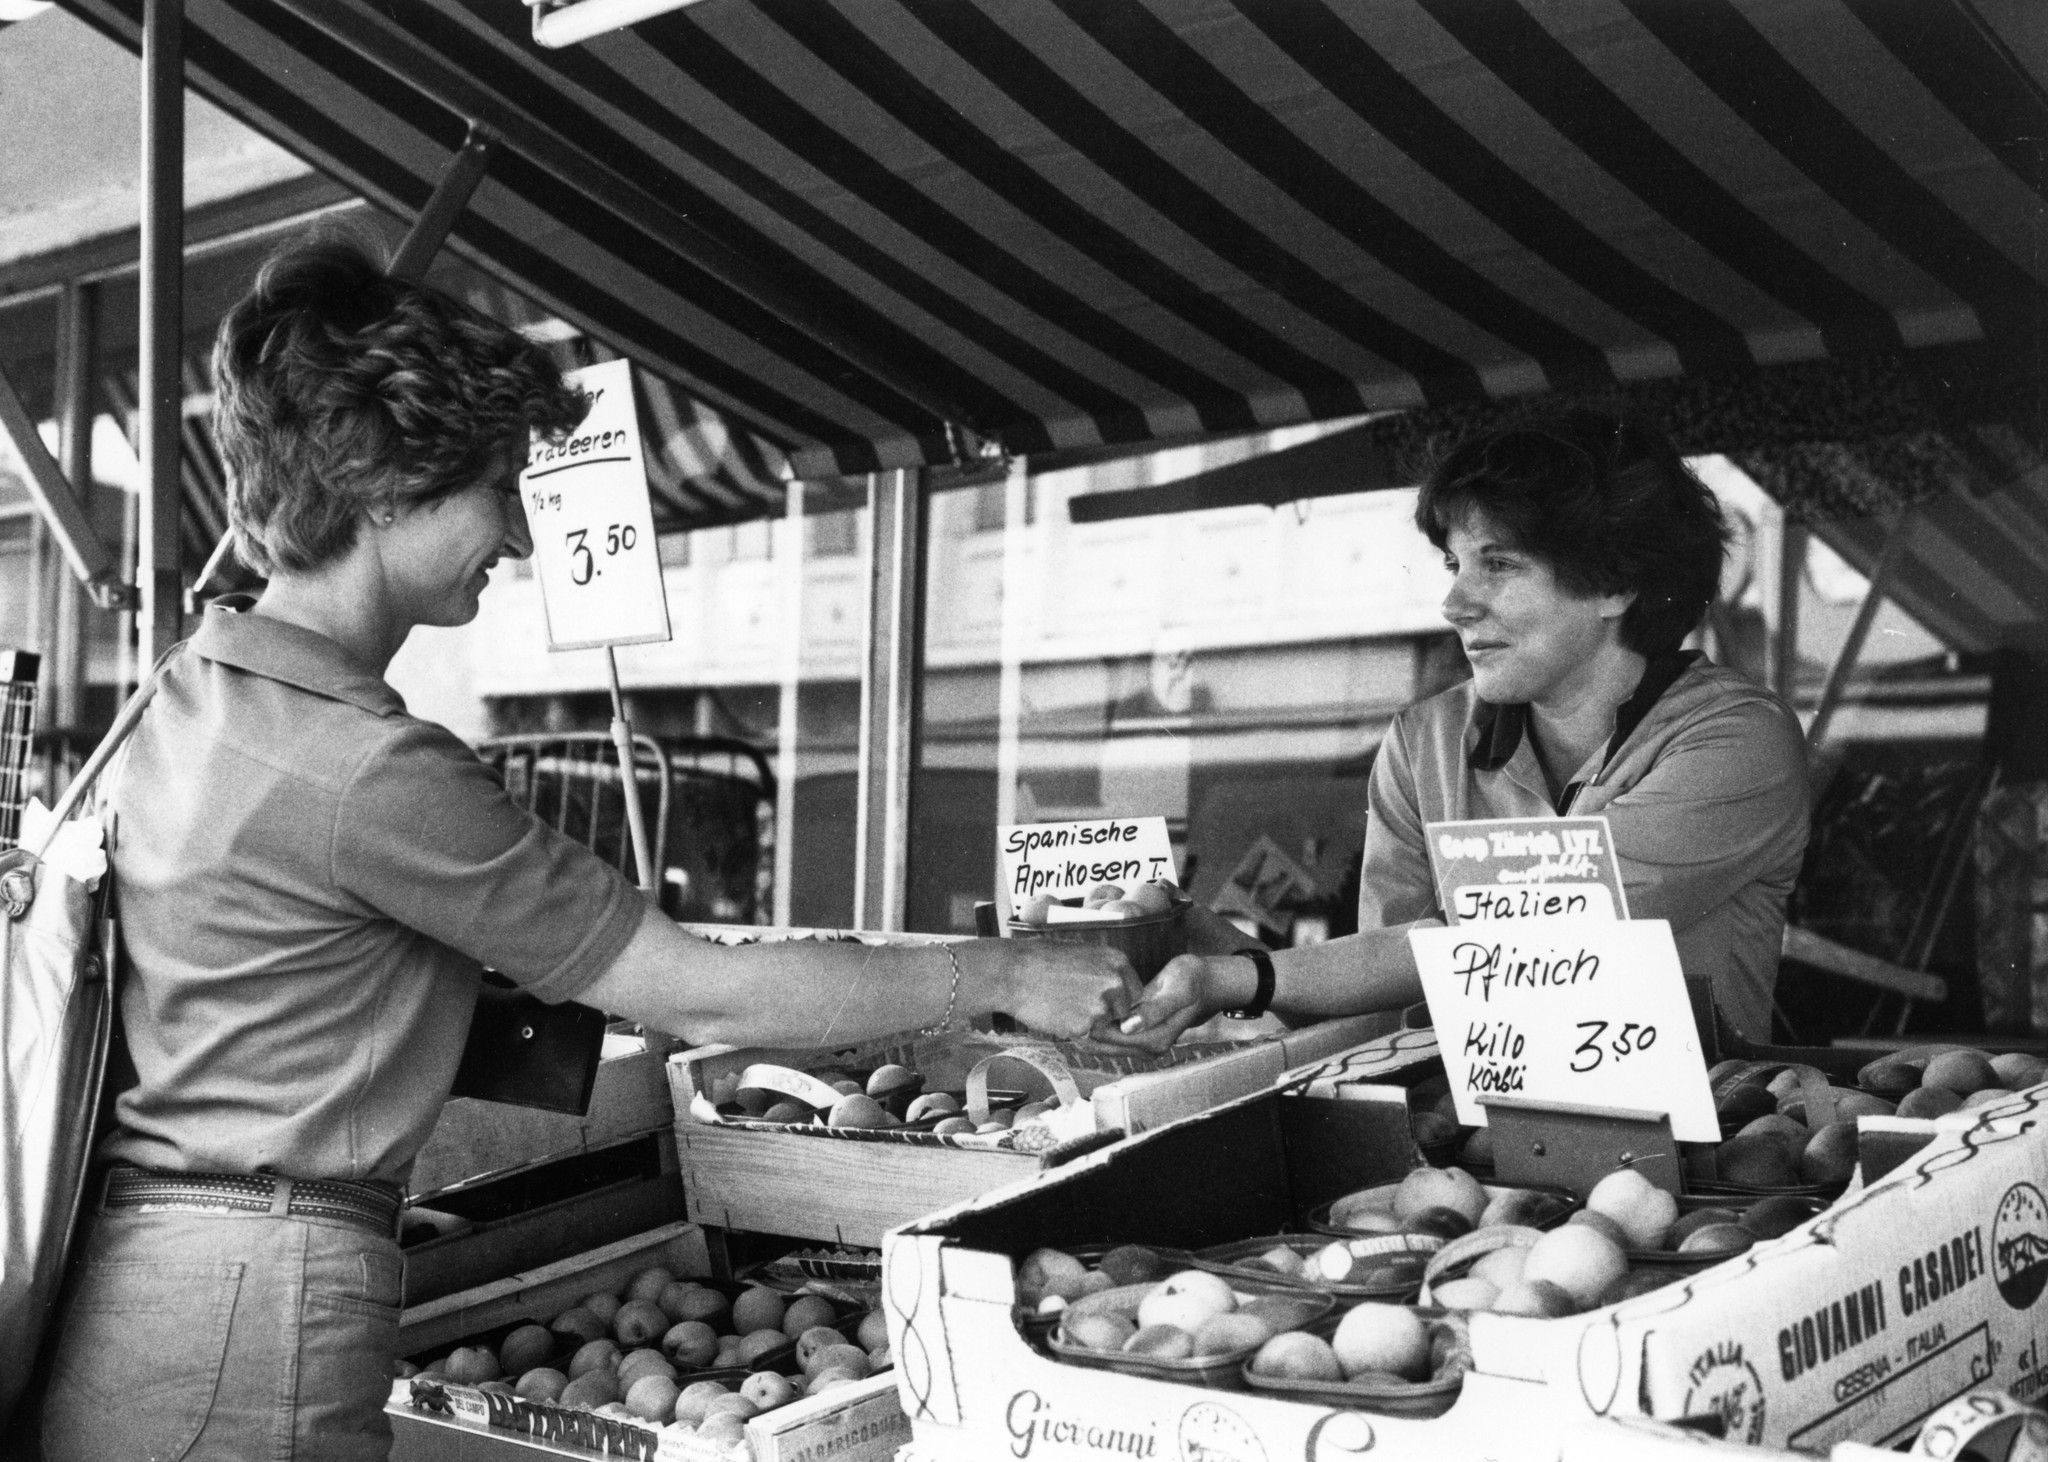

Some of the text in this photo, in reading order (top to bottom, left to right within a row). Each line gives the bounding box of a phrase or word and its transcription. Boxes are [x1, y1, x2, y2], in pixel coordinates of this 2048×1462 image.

[548, 491, 562, 512] kg
[565, 524, 638, 587] 3.50
[1005, 821, 1138, 863] Spanische
[1438, 834, 1489, 862] Coop
[1488, 830, 1561, 857] Zürich
[1014, 859, 1141, 897] Aprikosen
[1459, 891, 1586, 920] Italien
[1452, 942, 1600, 1002] Pfirsich
[1464, 1020, 1656, 1073] Kilo 3.50
[1778, 1279, 1886, 1382] GIOVANNI
[1899, 1226, 1984, 1317] CASADEI
[1689, 1339, 1743, 1388] ITALIA
[1834, 1355, 1891, 1403] CESENA
[1906, 1322, 1946, 1362] ITALIA
[1006, 1389, 1157, 1460] Giovanni
